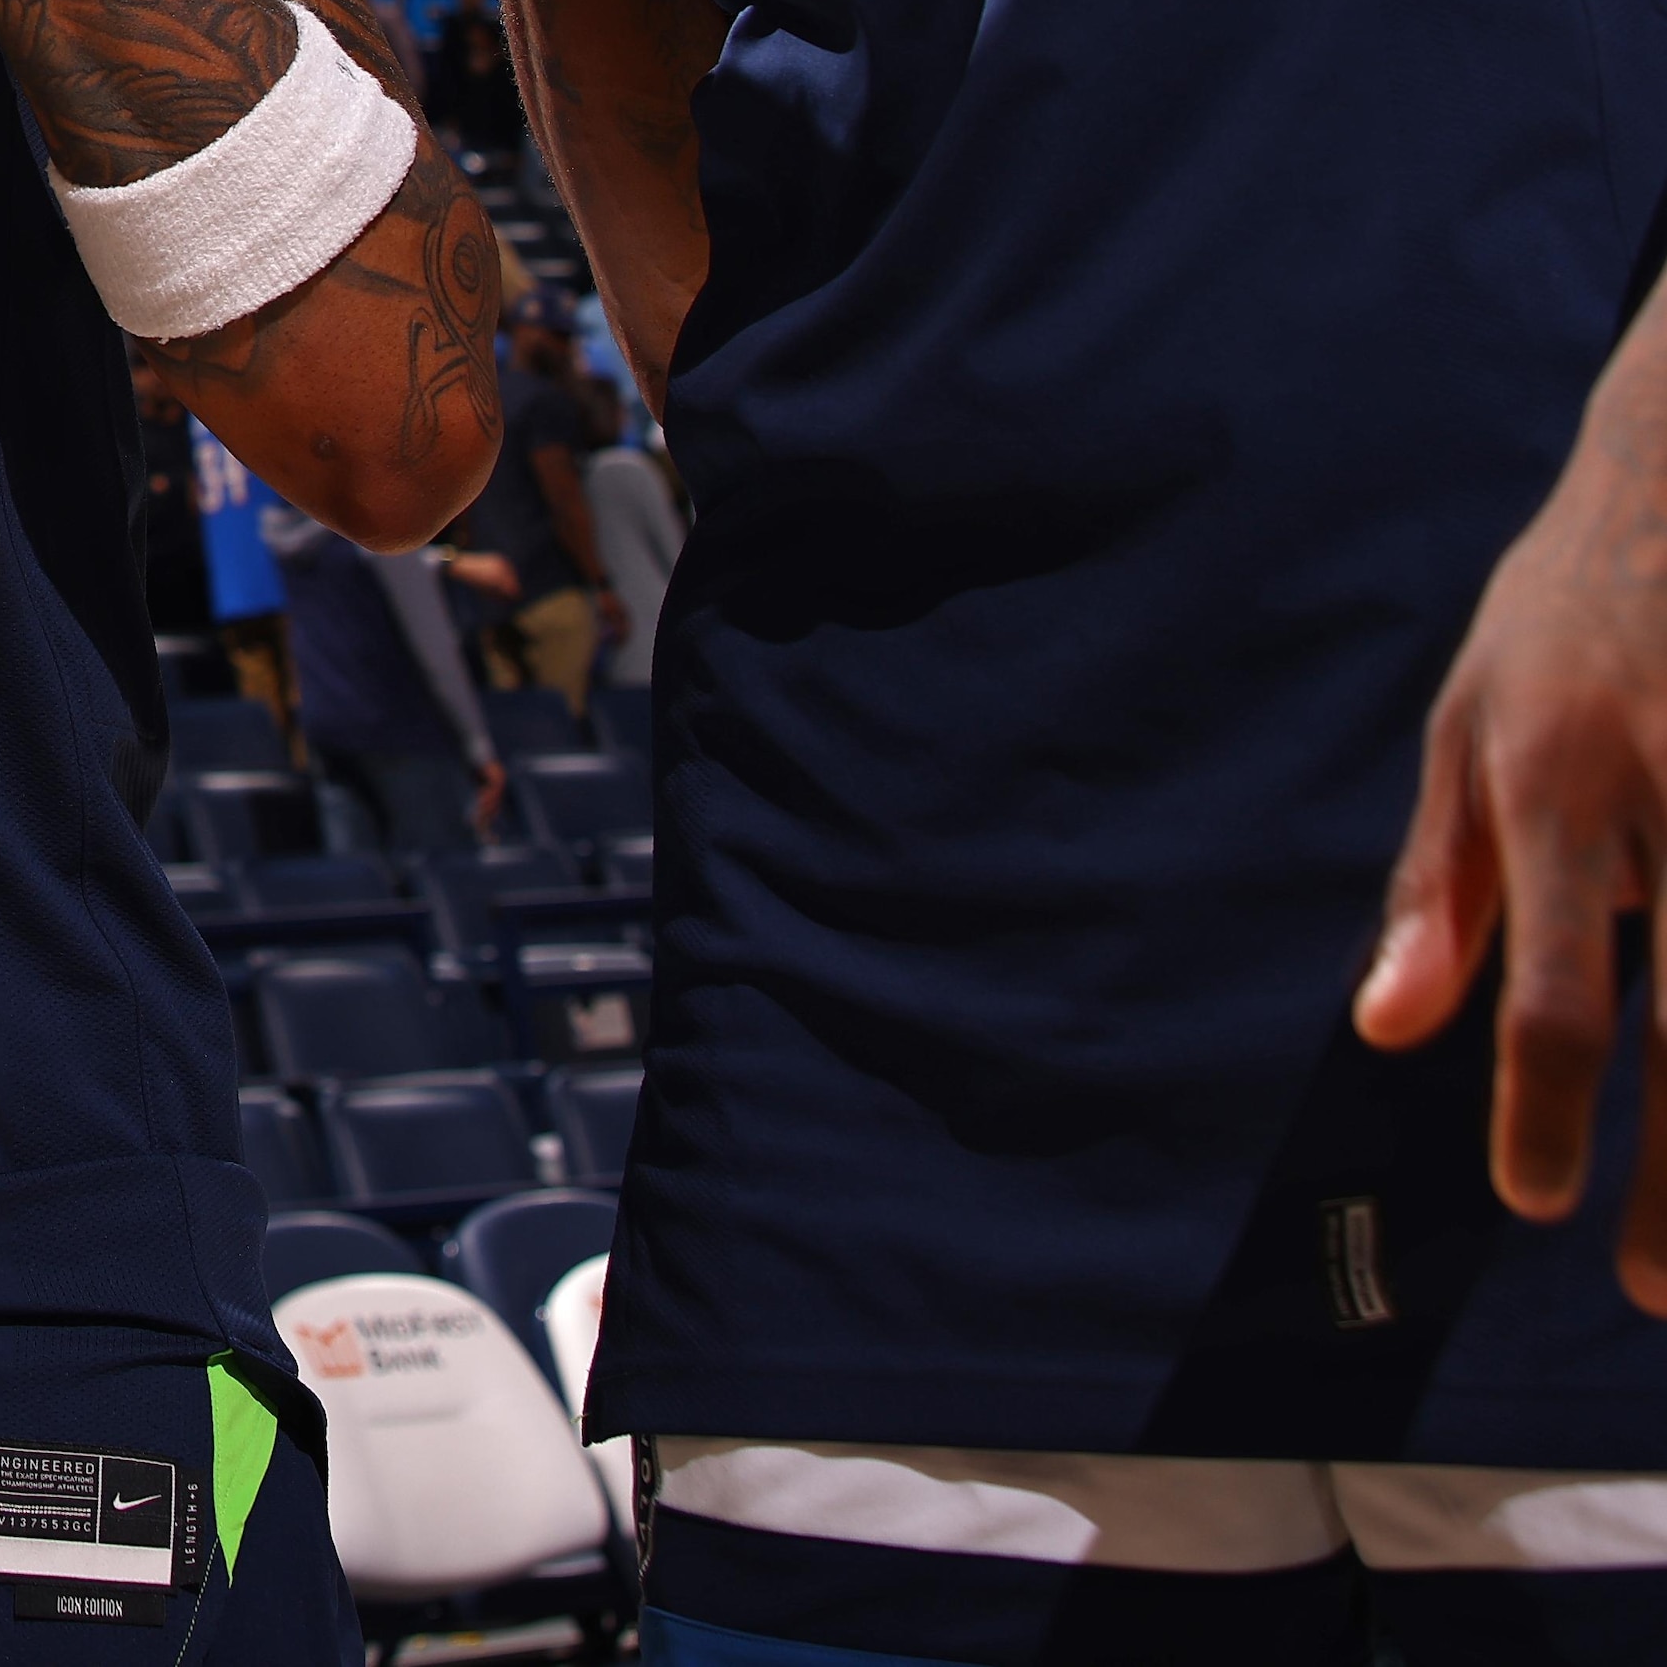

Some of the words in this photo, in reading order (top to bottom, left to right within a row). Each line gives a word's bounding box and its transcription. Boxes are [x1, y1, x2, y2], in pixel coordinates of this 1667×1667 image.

[1, 1470, 13, 1479] THE
[16, 1471, 38, 1481] EXACT
[40, 1473, 94, 1485] SPECIFICATIONS
[1, 1480, 55, 1490] CHAMPIONSHIP
[57, 1483, 94, 1493] ATHLETES
[57, 1595, 82, 1615] ICON
[84, 1597, 123, 1617] EDITION
